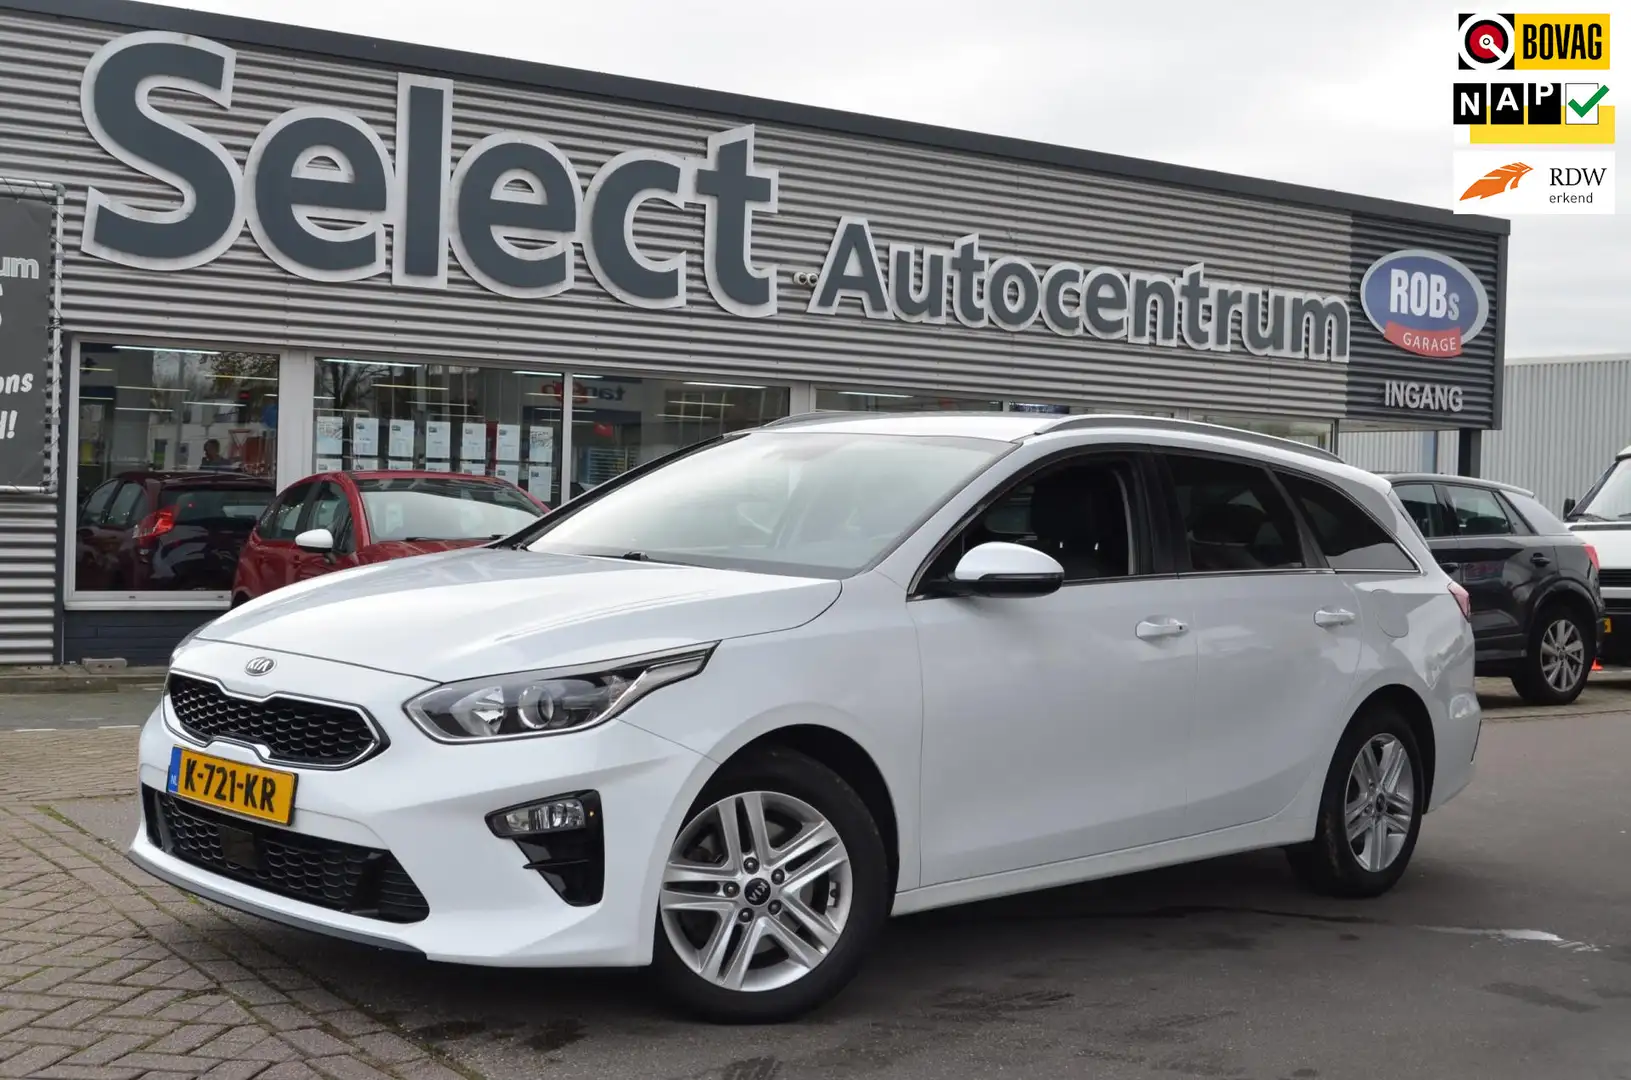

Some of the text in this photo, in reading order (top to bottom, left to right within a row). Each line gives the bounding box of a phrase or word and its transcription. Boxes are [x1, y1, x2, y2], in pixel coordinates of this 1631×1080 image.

[80, 30, 1350, 363] Select Autocentrum
[1389, 268, 1460, 321] ROBs
[1403, 332, 1457, 352] GARAGE
[1384, 380, 1463, 412] INGANG
[247, 659, 270, 671] KIA
[171, 775, 178, 786] NL
[184, 758, 276, 813] K-721-KR
